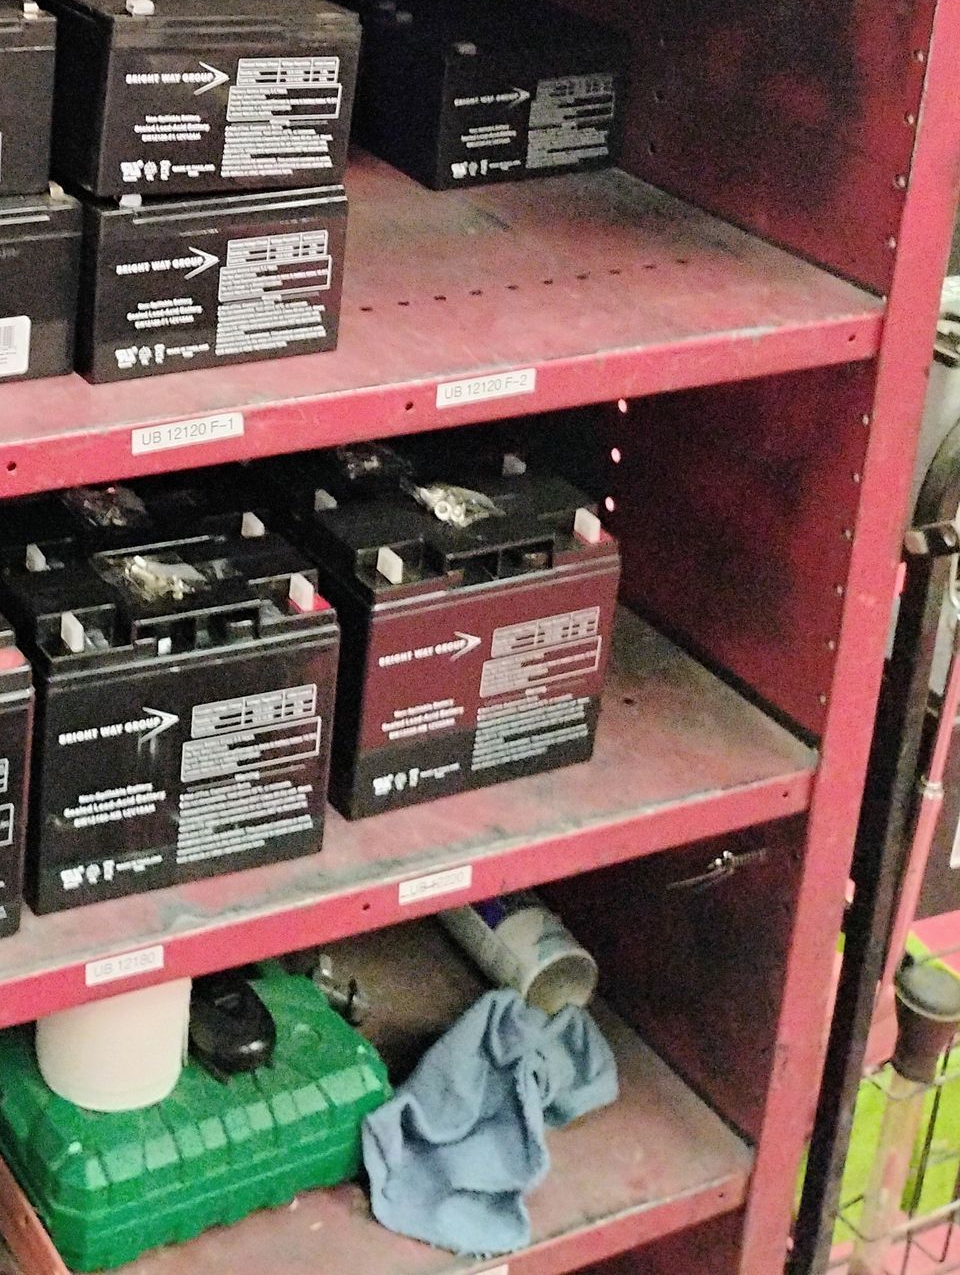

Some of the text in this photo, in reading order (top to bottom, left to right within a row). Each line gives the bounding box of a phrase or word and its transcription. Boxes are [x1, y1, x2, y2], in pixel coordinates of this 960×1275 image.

[150, 259, 172, 272] WAY
[172, 256, 204, 270] GROUP
[445, 374, 528, 400] UB 12120 F-2
[142, 418, 234, 446] UB 12120 F-1
[413, 645, 434, 659] WAY
[434, 638, 468, 655] GROUP
[58, 716, 161, 746] BRIGHT WAY GROUP
[94, 962, 113, 978] UB
